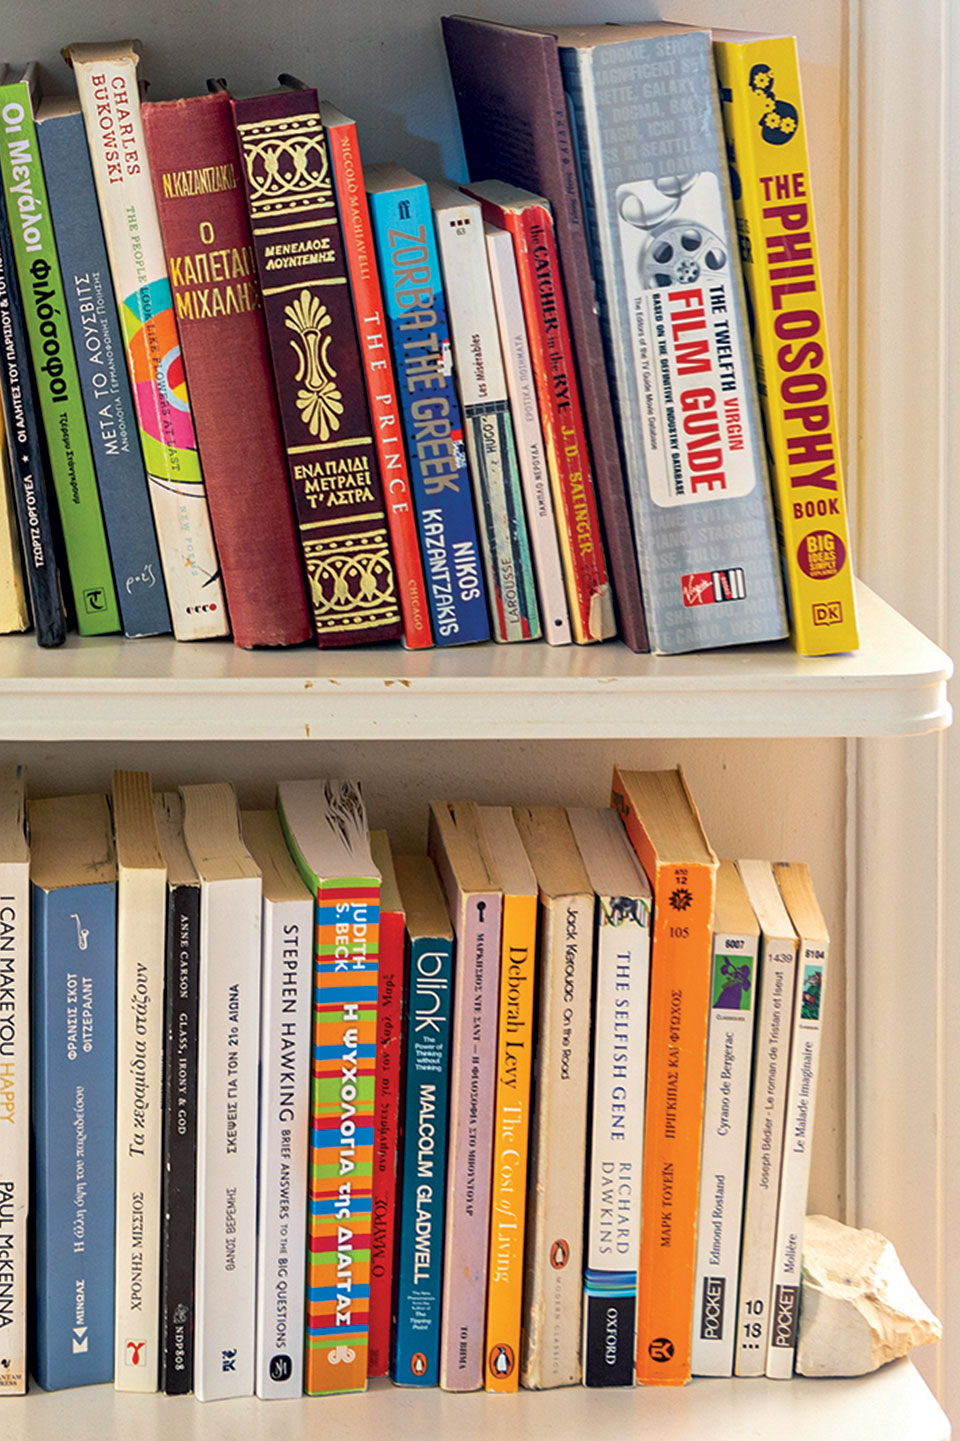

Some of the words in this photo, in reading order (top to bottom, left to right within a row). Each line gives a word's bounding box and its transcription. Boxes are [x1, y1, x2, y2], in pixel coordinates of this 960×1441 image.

[91, 74, 124, 184] BUKOWSKI
[111, 76, 140, 176] CHARLES
[340, 136, 357, 192] NICCOLÒ
[759, 172, 806, 202] THE
[348, 196, 370, 281] MACHIAVELLI
[388, 224, 436, 331] ZORBA
[708, 284, 726, 314] THE
[0, 299, 9, 308] &
[74, 273, 104, 364] ΑΟΥΣΒΙΤΣ
[2, 310, 16, 360] ΠΑΡΙΣΙΟΥ
[363, 312, 388, 372] THE
[668, 288, 712, 376] FILM
[712, 319, 738, 392] TWELFTH
[762, 202, 838, 491] PHILOSOPHY
[8, 362, 20, 384] ΤΟΥ
[92, 374, 110, 398] ΤΟ
[402, 333, 446, 393] THE
[10, 386, 25, 428] ΑΛΗΤΕΣ
[98, 405, 120, 454] ΜΕΤΑ
[723, 397, 745, 452] VIRGIN
[16, 430, 27, 442] ΟΙ
[375, 394, 410, 515] PRINCE
[410, 399, 460, 496] GREEK
[680, 386, 728, 494] GUIDE
[304, 470, 372, 494] ΜΕΤΡΑΕΙ
[792, 498, 840, 520] BOOK
[806, 534, 836, 552] BIG
[422, 508, 460, 636] KAZANTZAKIS
[452, 541, 480, 601] NIKOS
[500, 558, 520, 624] LAROUSSE
[408, 579, 423, 630] CHICAGO
[350, 902, 367, 969] JUDITH
[566, 907, 579, 940] Jack
[282, 924, 299, 1013] STEPHEN
[414, 951, 449, 1033] blink
[505, 946, 528, 1033] Deborah
[564, 944, 578, 1003] Kerouac
[616, 950, 632, 992] THE
[228, 984, 240, 1023] ΑΙΩΝΑ
[343, 1004, 358, 1020] Η
[563, 1008, 574, 1026] On
[562, 1028, 573, 1047] the
[613, 999, 630, 1079] SELFISH
[720, 1032, 735, 1080] Bergerac
[228, 1052, 238, 1076] ΤΟΝ
[228, 1078, 238, 1099] ΓΙΑ
[279, 1022, 296, 1122] HAWKING
[500, 1041, 525, 1090] Levy
[560, 1048, 572, 1080] Road
[720, 1082, 731, 1094] de
[799, 1042, 814, 1097] imaginaire
[340, 1028, 358, 1176] ΨΥΧΟΛΟΓΙΑ
[502, 1101, 523, 1143] The
[610, 1086, 627, 1141] GENE
[717, 1097, 732, 1136] Cyrano
[795, 1098, 810, 1137] Malade
[226, 1102, 238, 1154] ΣΚΕΨΕΙΣ
[280, 1129, 292, 1160] BRIEF
[418, 1084, 436, 1178] MALCOLM
[793, 1140, 806, 1154] Le
[279, 1164, 290, 1220] ANSWERS
[498, 1148, 521, 1194] Cost
[711, 1174, 725, 1218] Rostand
[226, 1186, 236, 1234] ΒΕΡΕΜΗΣ
[334, 1182, 352, 1219] της
[496, 1199, 519, 1220] of
[599, 1162, 614, 1255] DAWKINS
[616, 1162, 632, 1255] RICHARD
[225, 1237, 236, 1272] ΘΑΝΟΣ
[280, 1224, 288, 1238] TO
[280, 1239, 288, 1254] THE
[414, 1184, 432, 1284] GLADWELL
[494, 1222, 518, 1282] Living
[709, 1220, 723, 1266] Edmond
[783, 1234, 797, 1274] Molière
[278, 1258, 289, 1277] BIG
[336, 1226, 354, 1327] ΔΙΑΙΤΑΣ
[76, 1280, 85, 1326] ΜΙΝΩΑΣ
[276, 1280, 288, 1349] QUESTIONS
[703, 1276, 721, 1340] POCKET
[776, 1284, 798, 1348] POCKET
[175, 1326, 185, 1372] NDP808
[604, 1308, 618, 1364] OXFORD
